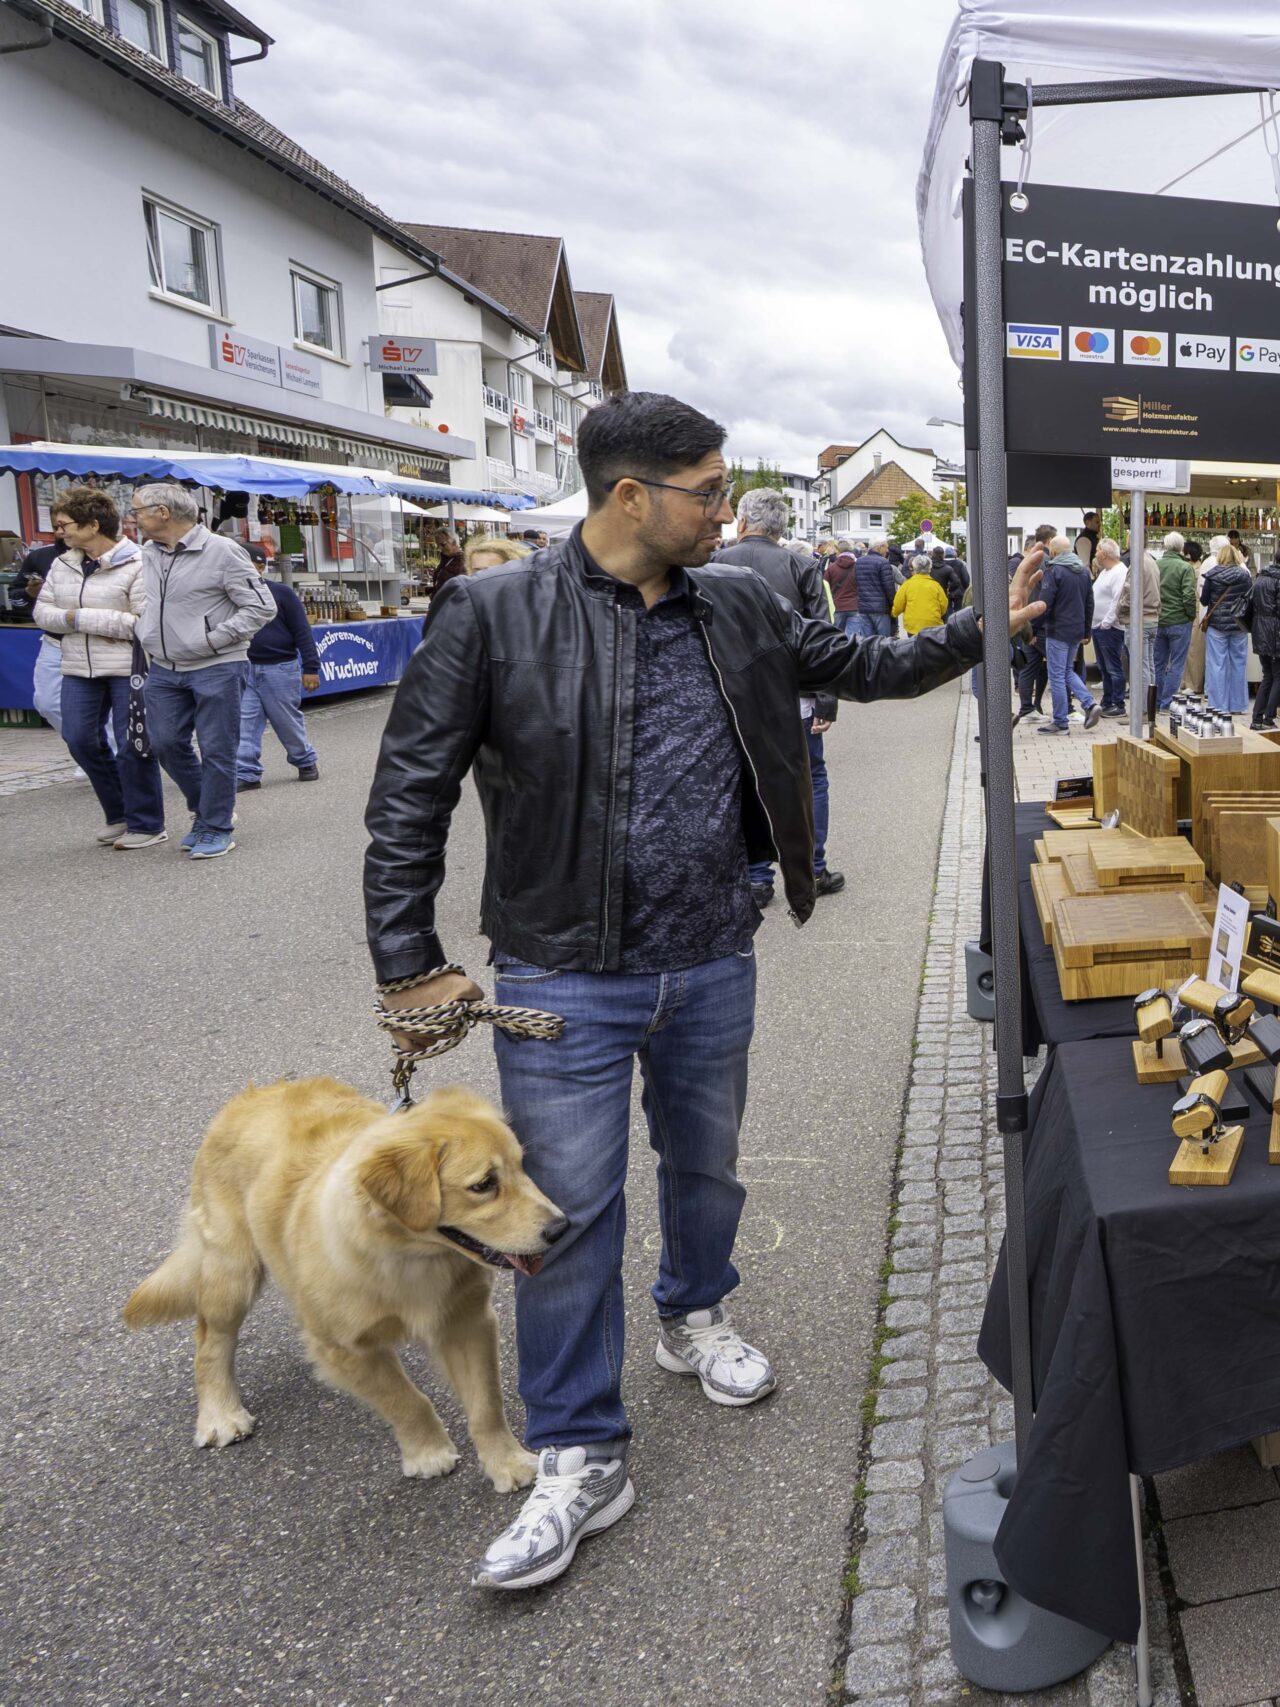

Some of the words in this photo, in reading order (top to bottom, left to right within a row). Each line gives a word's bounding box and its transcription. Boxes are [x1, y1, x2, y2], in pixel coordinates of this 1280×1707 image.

[1088, 281, 1213, 313] möglich
[1015, 333, 1053, 349] VISA
[247, 348, 276, 366] Sparkassen
[1196, 342, 1226, 363] Pay
[245, 359, 277, 378] Versicherung
[378, 364, 403, 372] Michael
[403, 365, 430, 374] Lampert
[285, 371, 303, 384] Michael
[1142, 400, 1172, 411] Miller
[1142, 412, 1199, 421] Holzmanufaktur
[1113, 468, 1161, 479] gesperrt!
[320, 657, 379, 681] Wuchner
